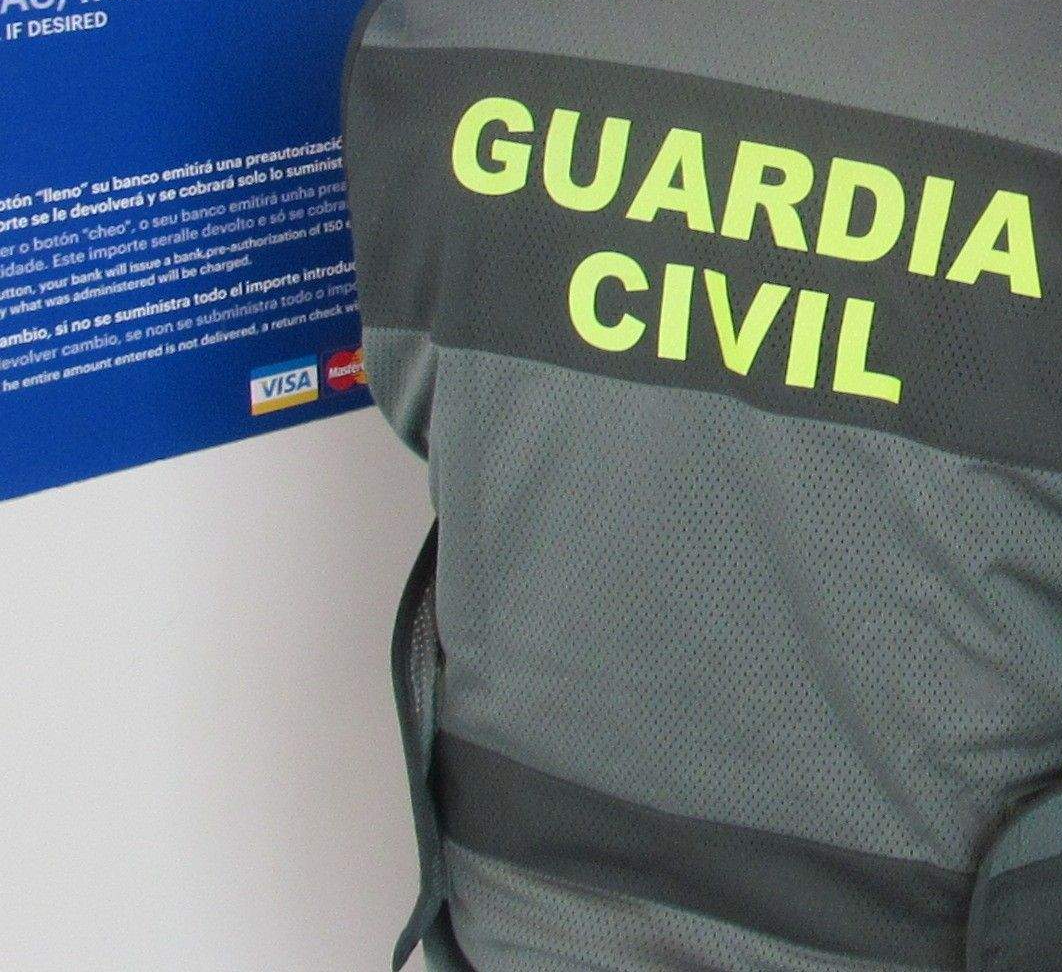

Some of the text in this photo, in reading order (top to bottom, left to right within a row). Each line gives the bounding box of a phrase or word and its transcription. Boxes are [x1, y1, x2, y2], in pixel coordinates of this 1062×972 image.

[6, 11, 108, 40] IF DESIRED
[31, 212, 49, 225] se
[52, 207, 67, 221] le
[70, 191, 144, 218] devolverá
[147, 192, 156, 206] y
[159, 188, 177, 201] se
[179, 174, 234, 197] cobrará
[238, 169, 267, 186] solo
[270, 166, 283, 180] lo
[91, 181, 109, 194] su
[112, 172, 159, 190] banco
[162, 158, 213, 181] emitirá
[216, 157, 242, 171] una
[451, 96, 1042, 299] GUARDIA
[20, 242, 29, 253] o
[33, 231, 79, 250] botón
[139, 219, 149, 229] o
[152, 214, 178, 227] seu
[181, 204, 226, 221] banco
[281, 185, 315, 202] unha
[53, 252, 85, 267] Este
[89, 239, 147, 260] importe
[201, 217, 255, 237] devolto
[258, 215, 266, 226] e
[39, 278, 69, 294] your
[71, 268, 101, 285] bank
[104, 263, 127, 278] will
[163, 256, 171, 266] a
[308, 222, 321, 235] of
[9, 299, 42, 314] what
[44, 294, 70, 306] was
[73, 274, 156, 301] administered
[158, 269, 180, 283] will
[181, 267, 197, 279] be
[54, 319, 69, 335] si
[70, 318, 91, 332] no
[94, 314, 112, 326] se
[114, 297, 190, 322] suministra
[193, 287, 227, 305] todo
[229, 282, 242, 297] el
[245, 272, 301, 293] importe
[124, 329, 141, 341] se
[145, 322, 174, 337] non
[176, 318, 193, 330] se
[281, 290, 311, 307] todo
[21, 370, 60, 386] entire
[62, 357, 111, 377] amount
[114, 344, 162, 365] entered
[163, 343, 175, 354] is
[178, 337, 199, 350] not
[270, 314, 306, 330] return
[568, 251, 902, 404] CIVIL
[262, 371, 311, 398] VISA
